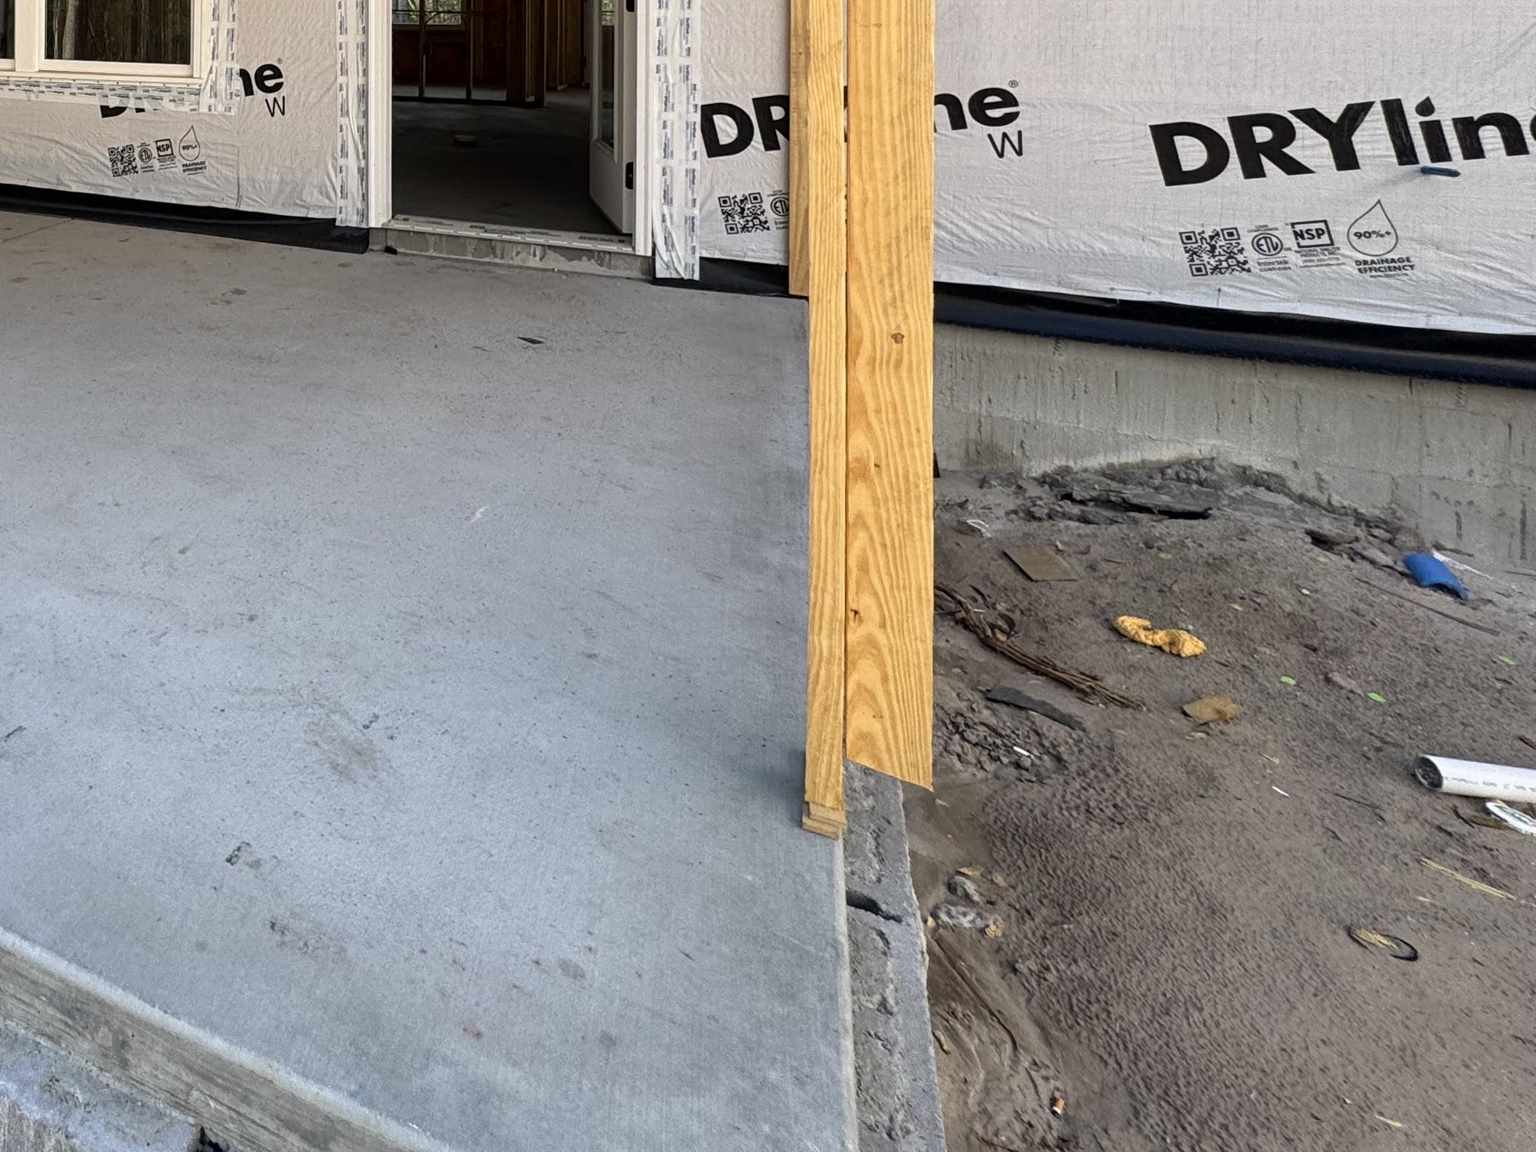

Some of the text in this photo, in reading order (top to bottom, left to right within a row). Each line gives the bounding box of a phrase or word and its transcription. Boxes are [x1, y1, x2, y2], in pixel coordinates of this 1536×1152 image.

[265, 95, 286, 118] W
[987, 129, 1025, 160] W
[1148, 95, 1536, 188] DRYlin
[1292, 228, 1326, 241] NSP
